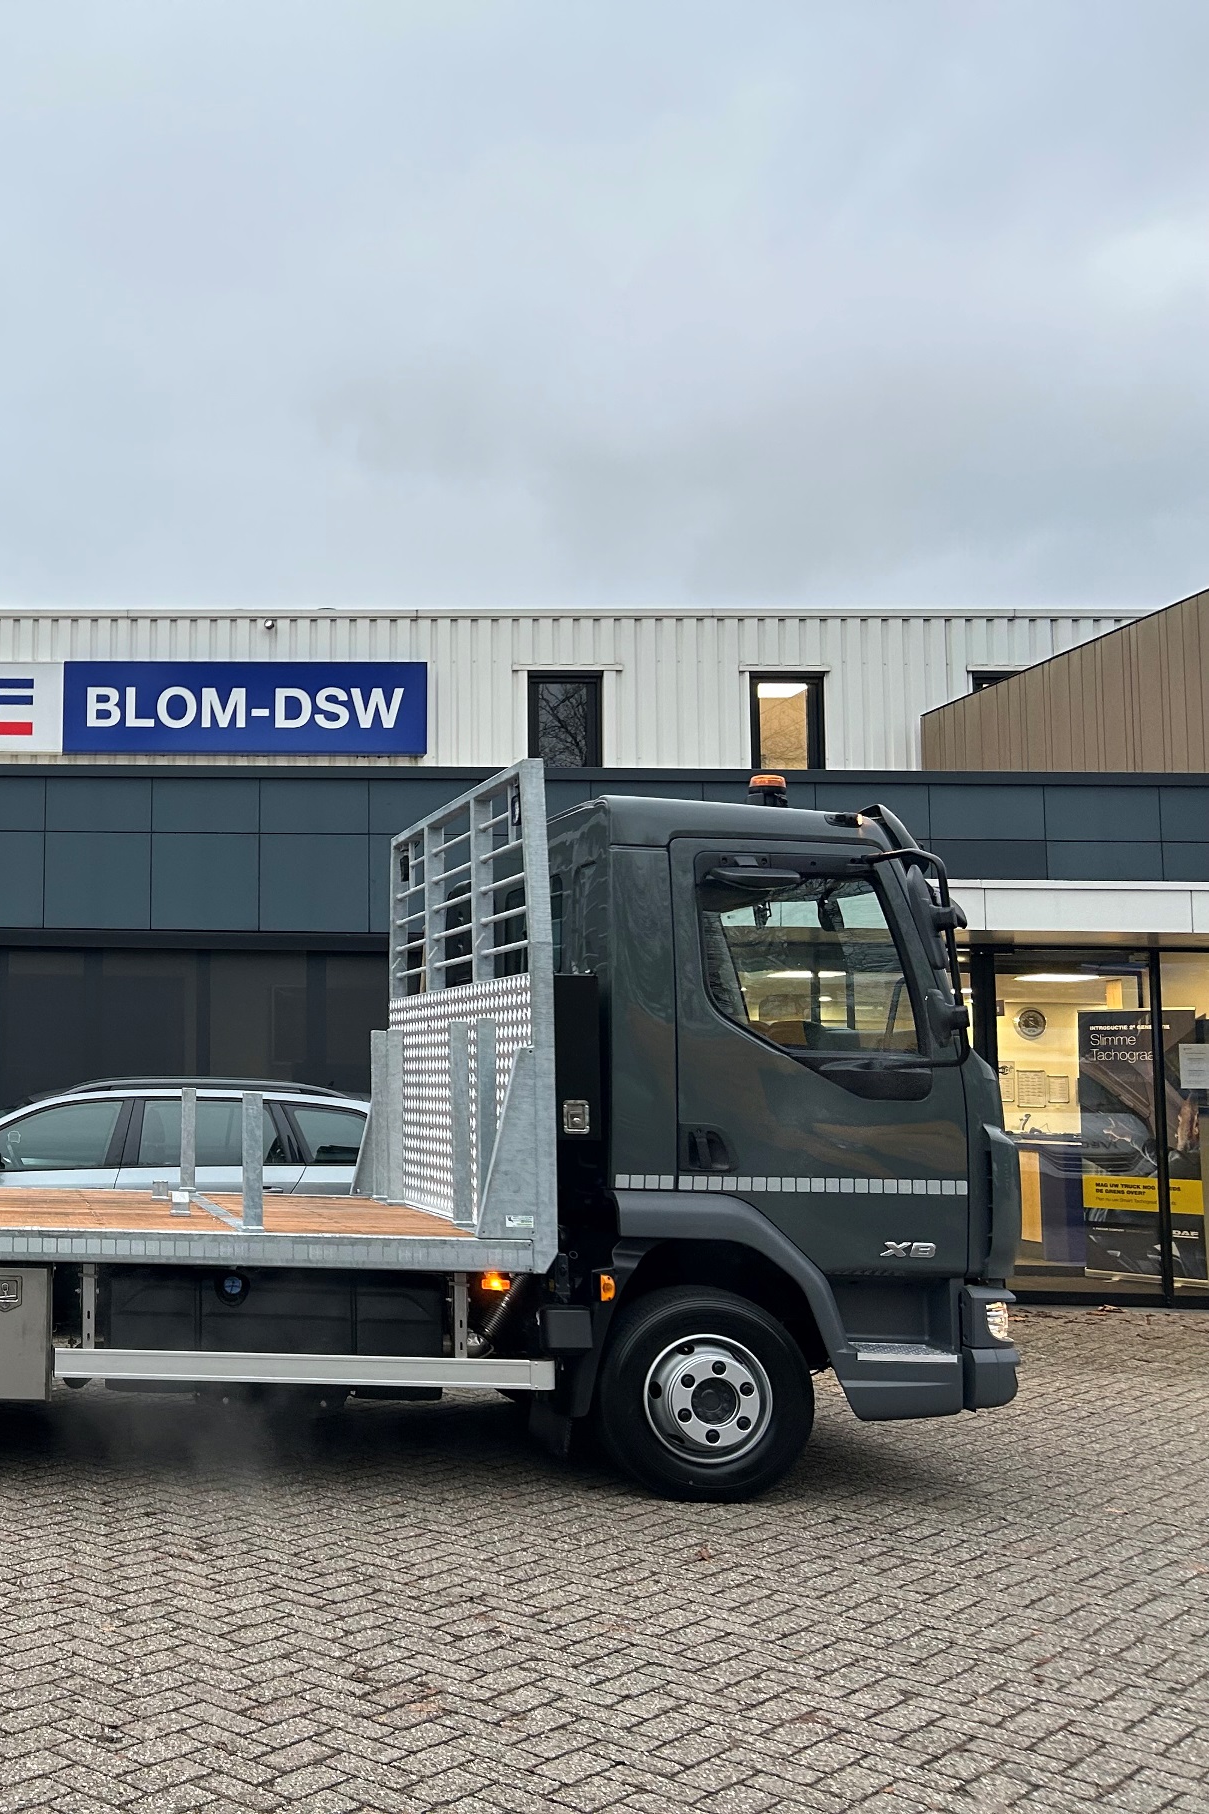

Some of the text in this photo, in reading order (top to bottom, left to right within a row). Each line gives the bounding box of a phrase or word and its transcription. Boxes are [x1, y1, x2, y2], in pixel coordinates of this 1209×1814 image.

[86, 686, 405, 729] BLOM-DSW
[1090, 1033, 1137, 1046] Slimme
[1090, 1048, 1154, 1063] Tachograa
[880, 1241, 937, 1258] XB
